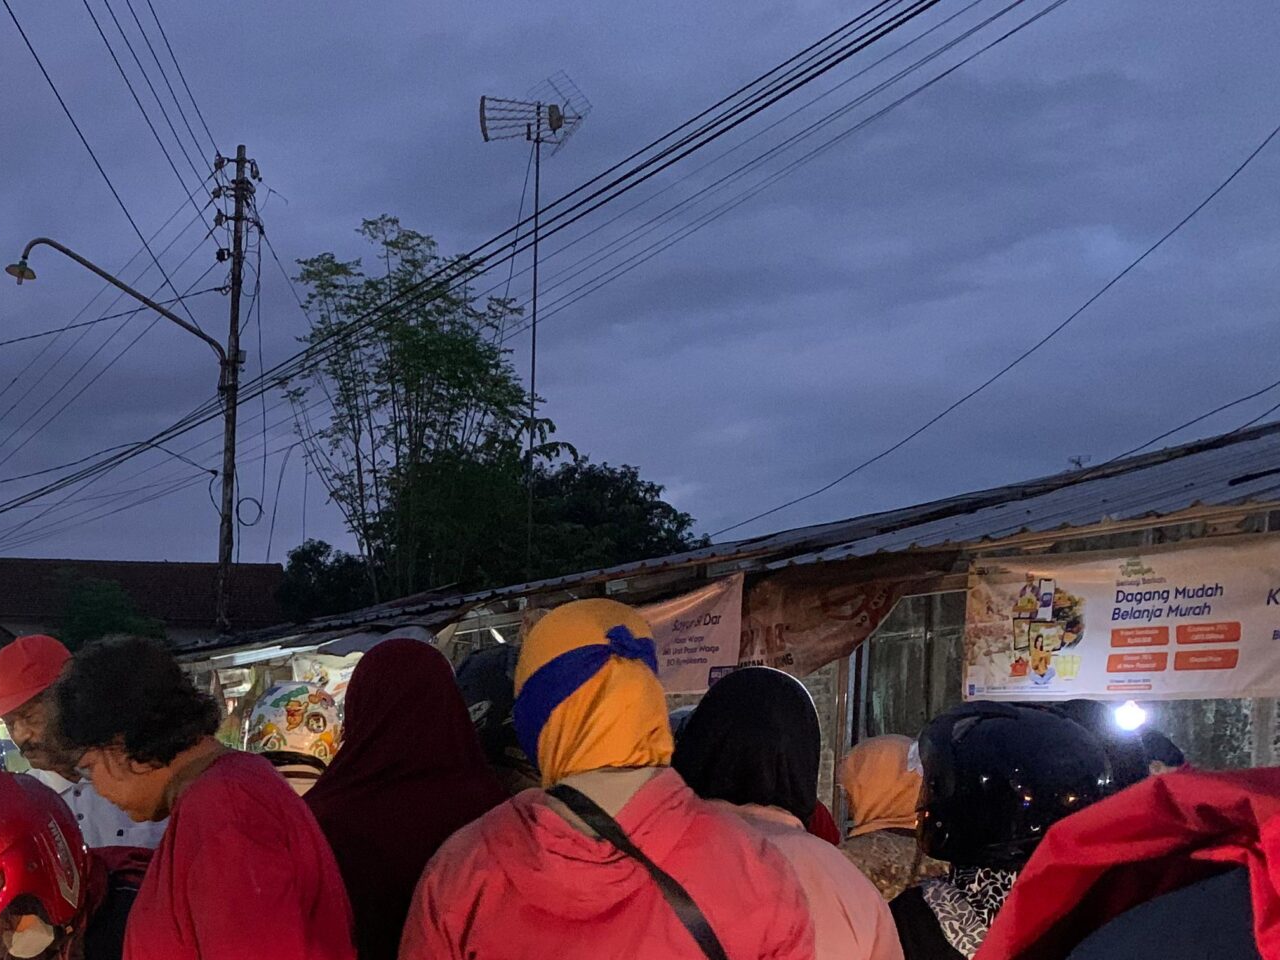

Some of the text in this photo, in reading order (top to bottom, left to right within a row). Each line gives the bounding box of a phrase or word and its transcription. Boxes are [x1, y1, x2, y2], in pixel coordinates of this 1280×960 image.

[1115, 583, 1224, 605] Dagang Mudah
[1111, 603, 1211, 622] Belanja Murah
